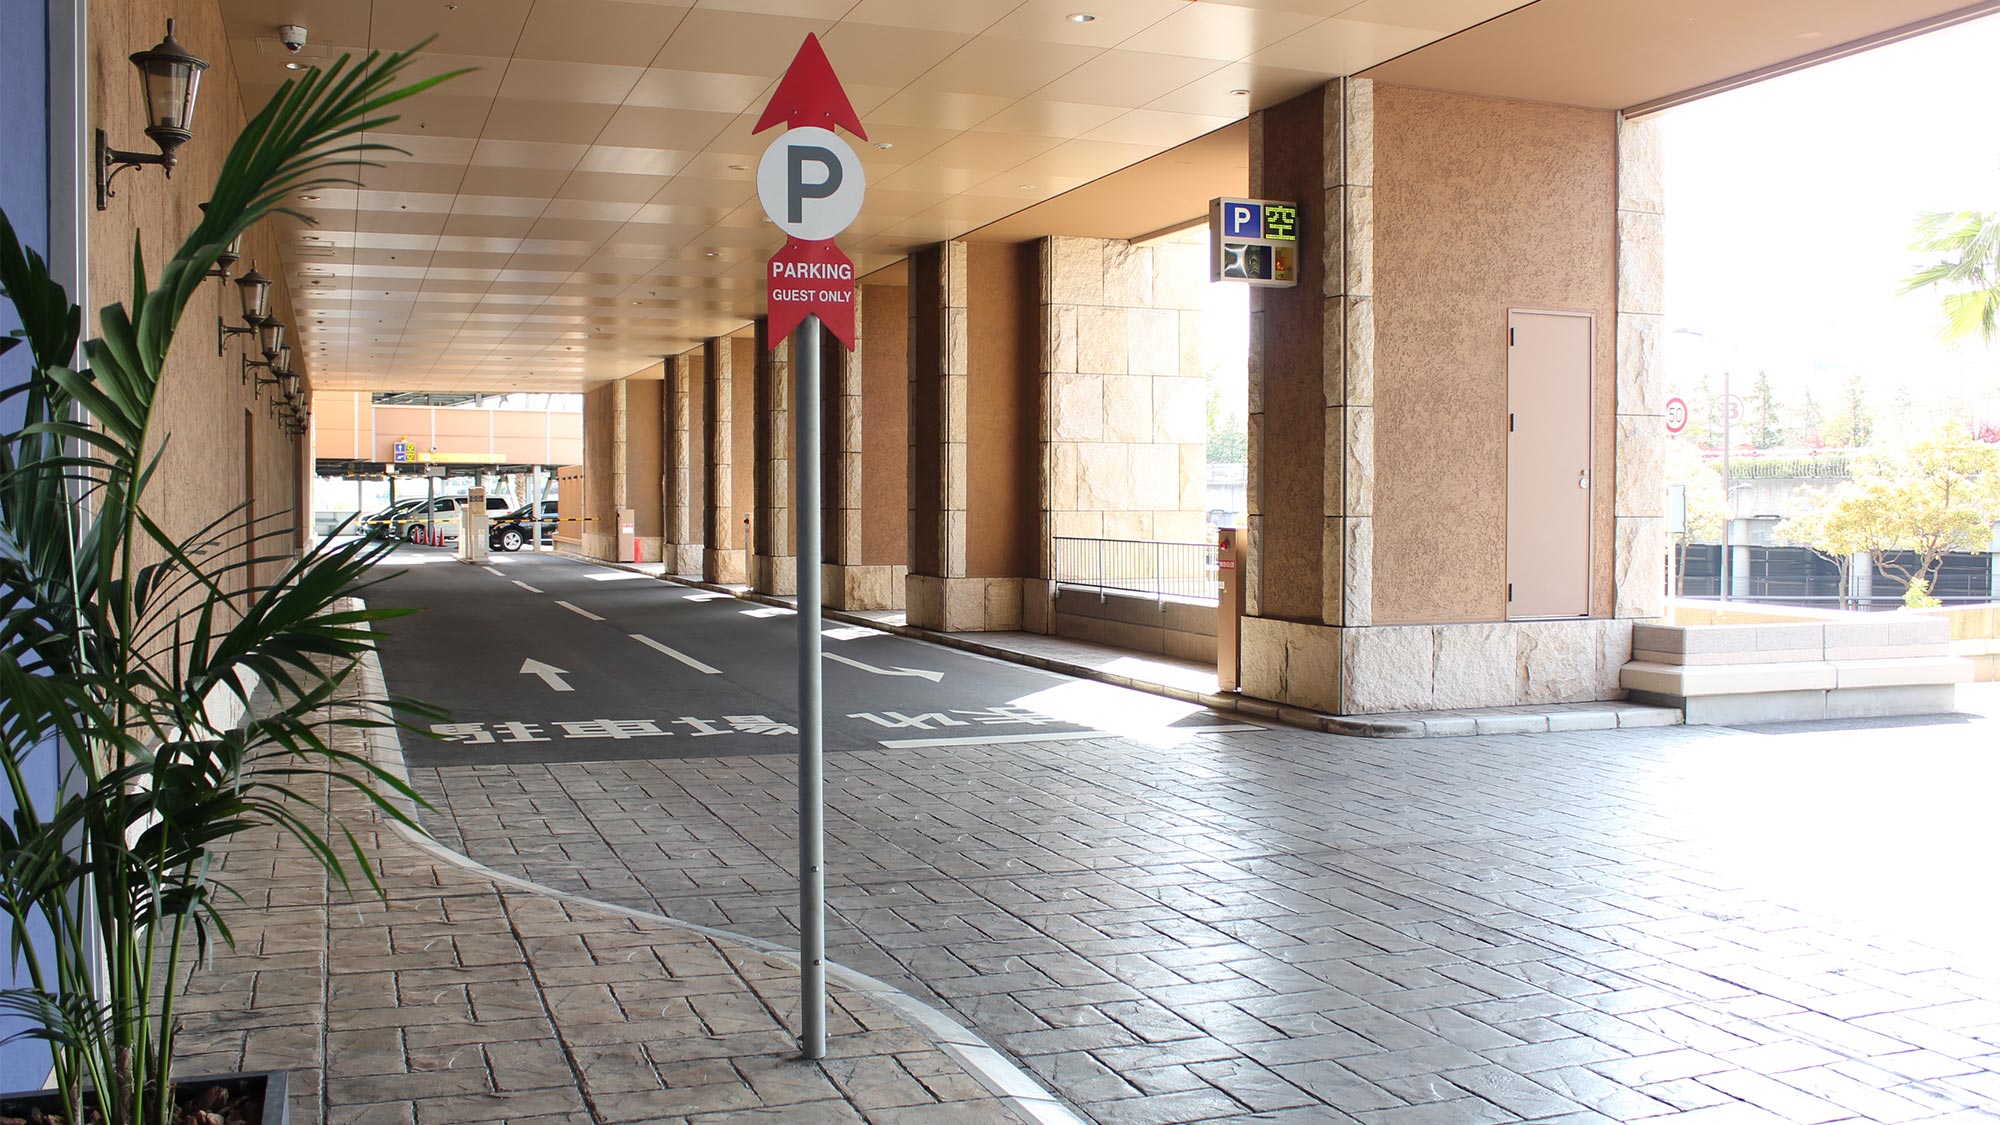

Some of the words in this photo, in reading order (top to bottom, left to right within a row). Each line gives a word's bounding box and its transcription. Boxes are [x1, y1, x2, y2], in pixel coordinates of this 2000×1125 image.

[787, 144, 844, 224] P
[1234, 206, 1251, 234] P
[1265, 205, 1296, 241] 空
[772, 261, 852, 280] PARKING
[772, 288, 816, 302] GUEST
[818, 290, 852, 303] ONLY
[1668, 407, 1683, 423] 50
[429, 714, 799, 744] 駐車場
